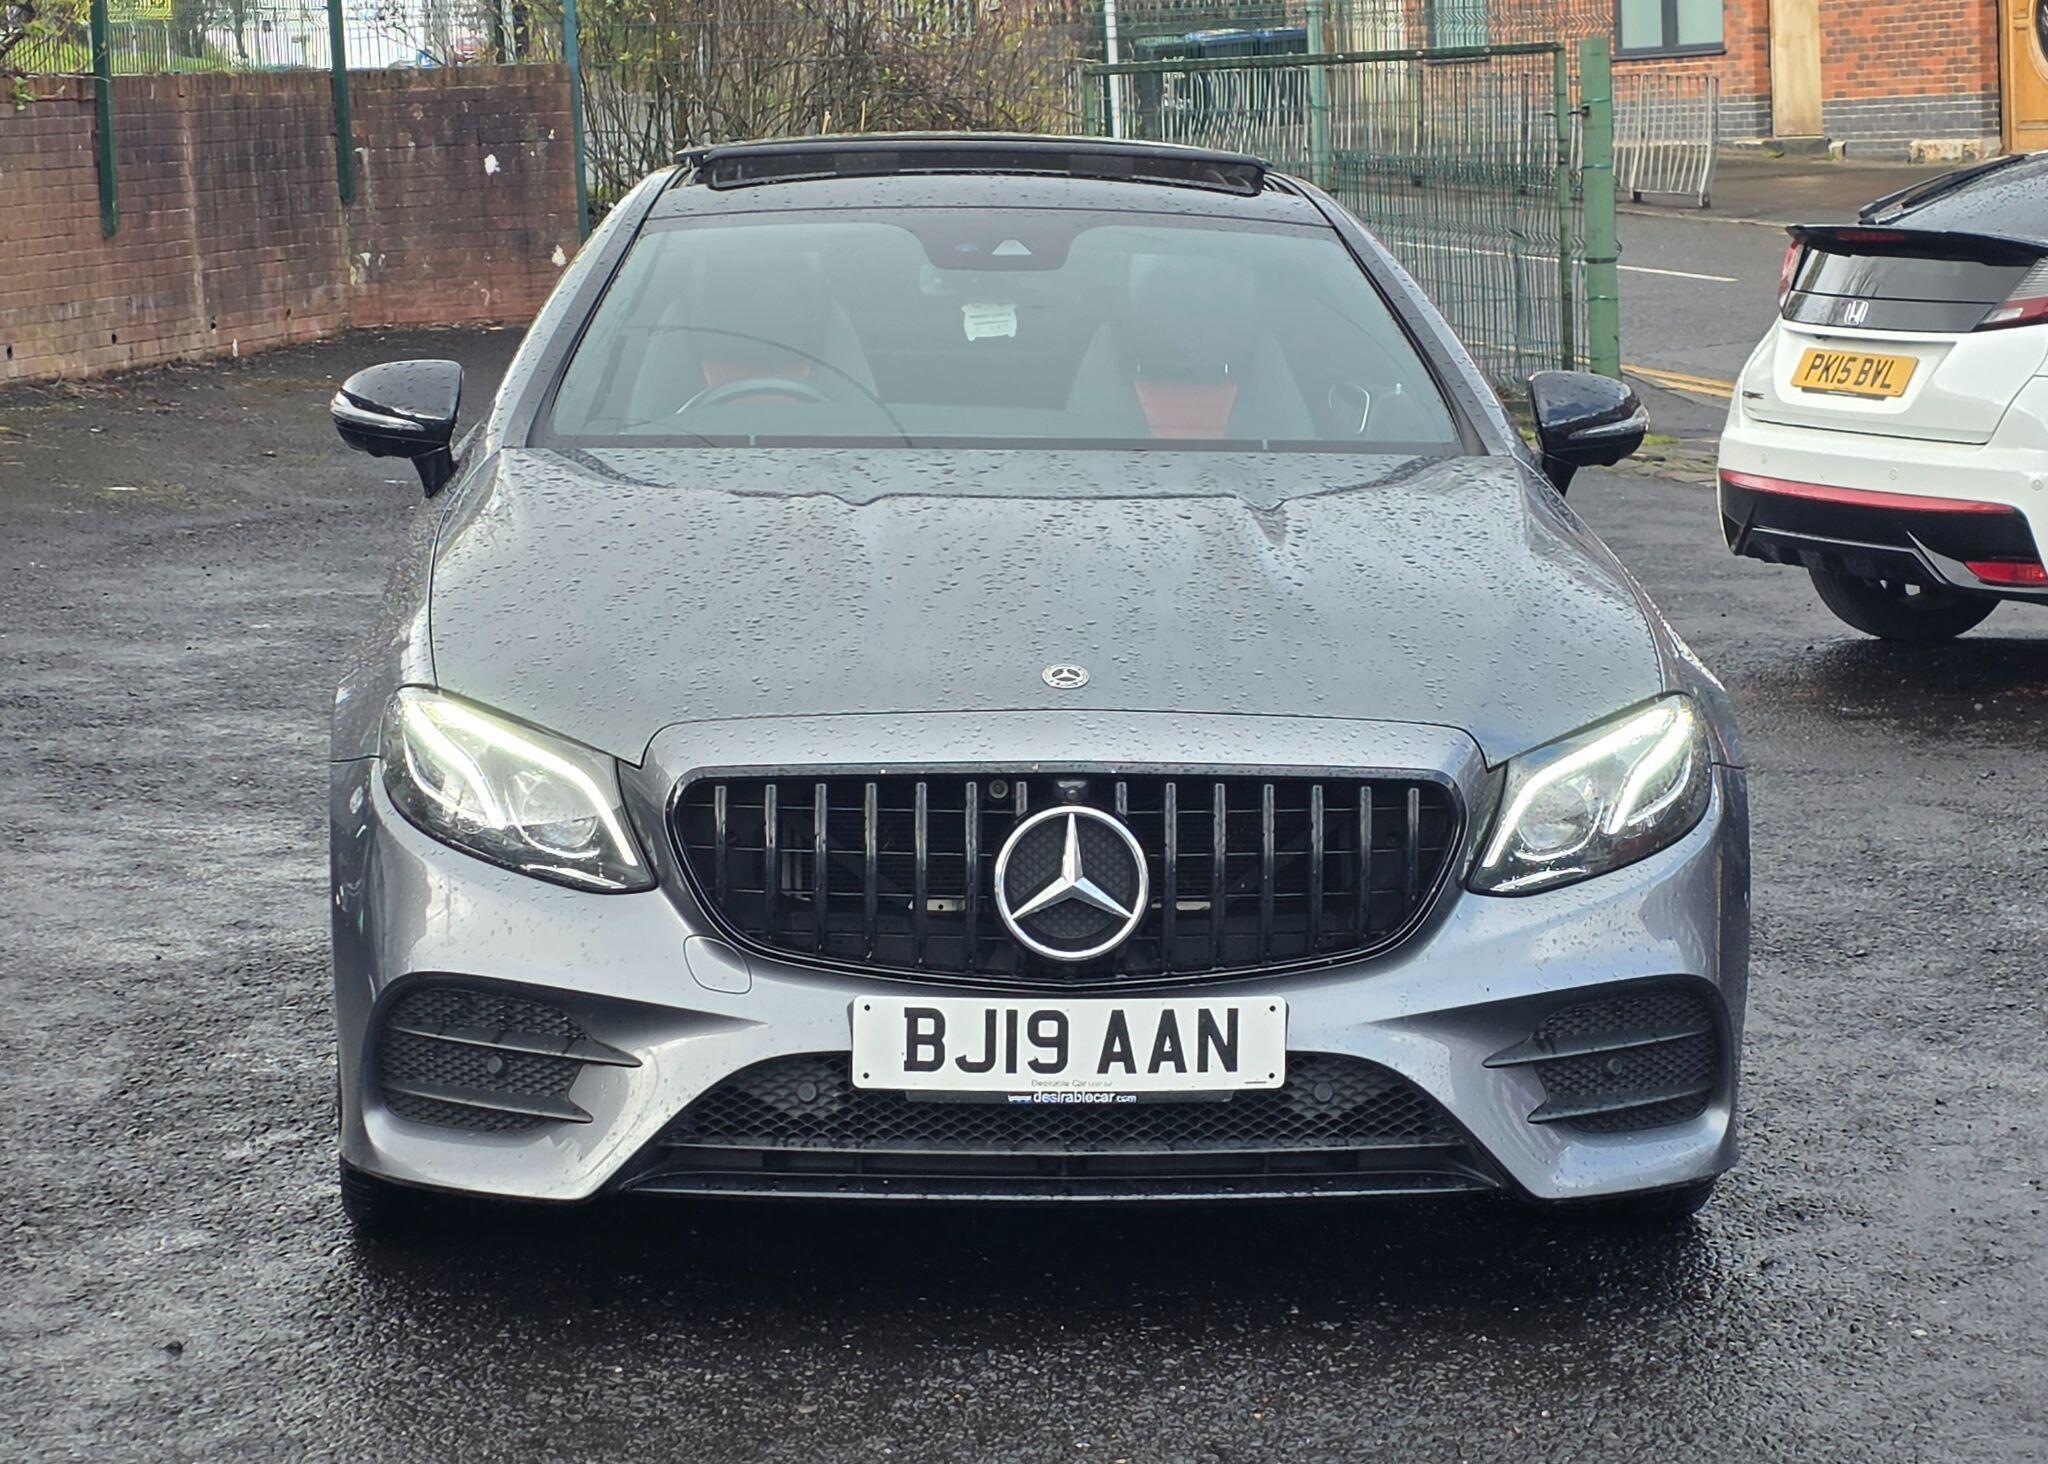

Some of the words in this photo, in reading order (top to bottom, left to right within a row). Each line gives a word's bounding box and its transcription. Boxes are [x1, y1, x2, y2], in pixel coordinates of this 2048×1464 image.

[1804, 353, 1858, 384] PK15
[903, 1006, 1069, 1074] BJ19
[1097, 1008, 1239, 1074] AAN
